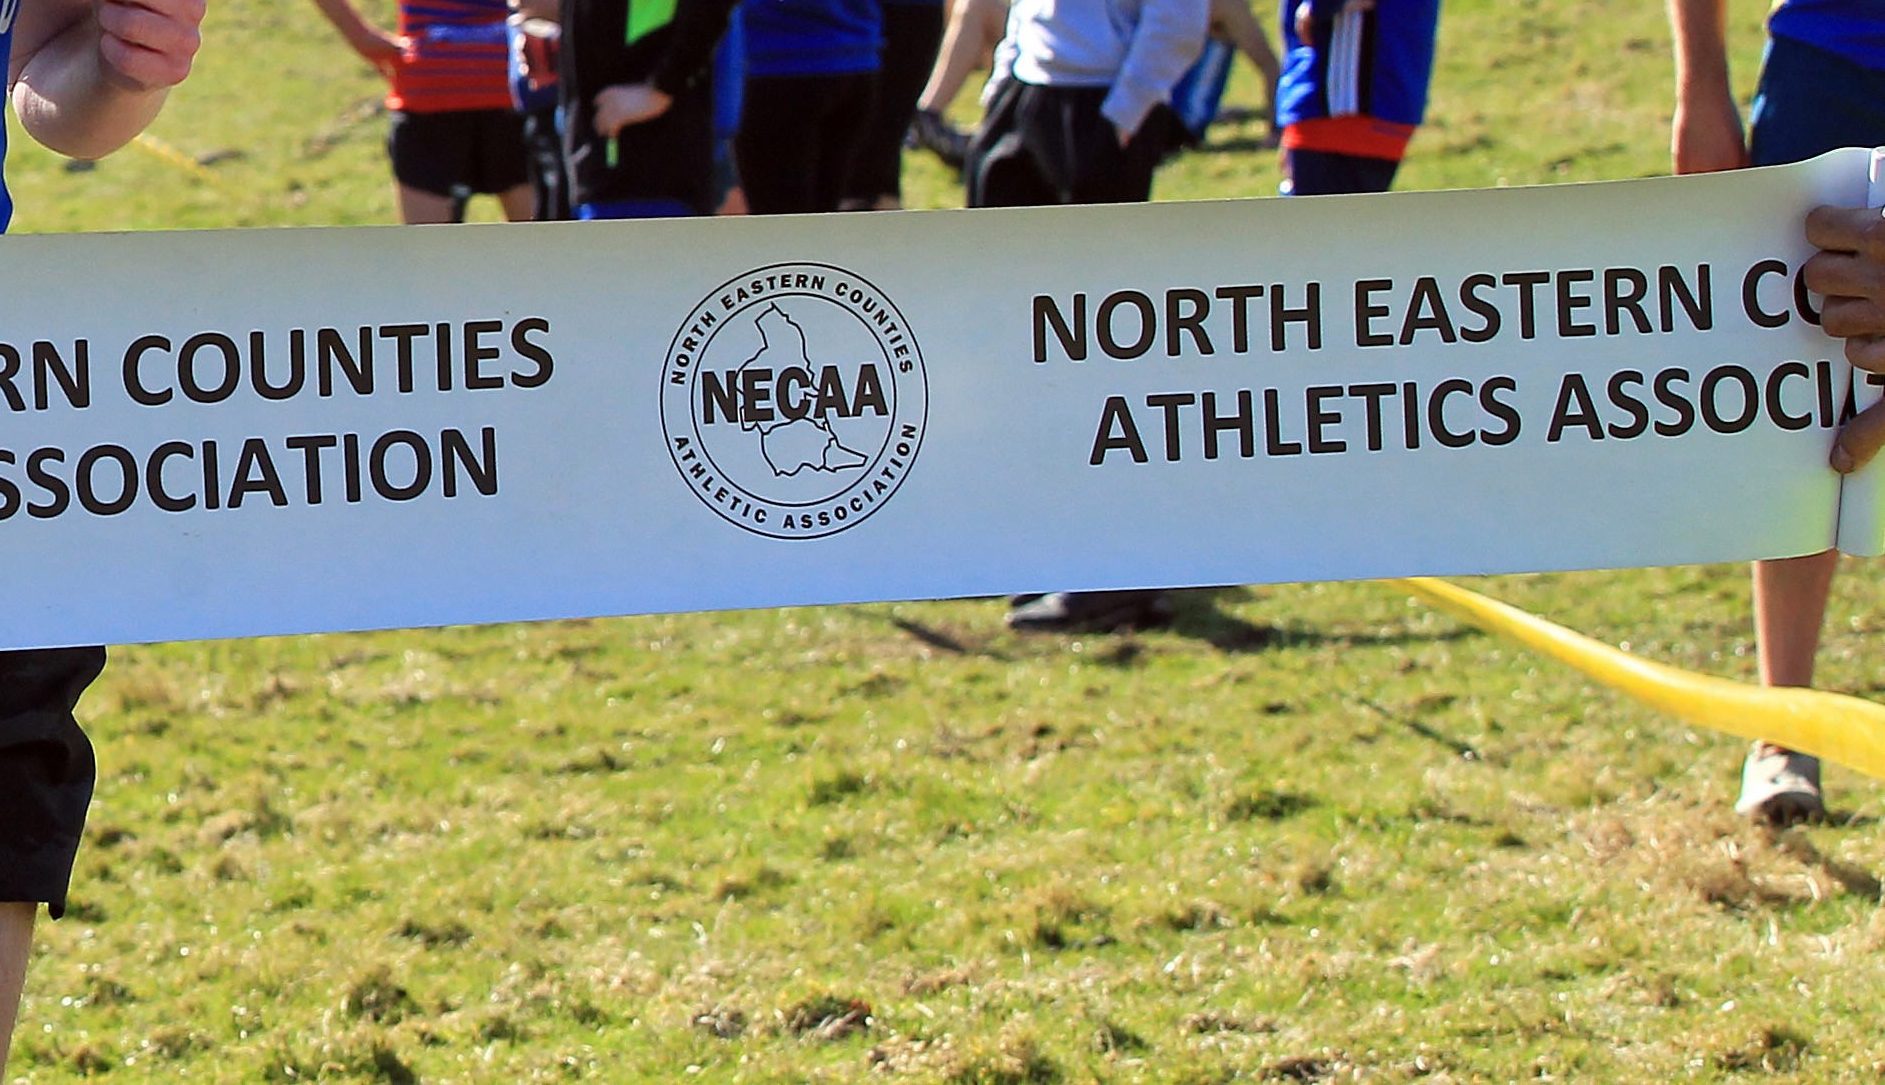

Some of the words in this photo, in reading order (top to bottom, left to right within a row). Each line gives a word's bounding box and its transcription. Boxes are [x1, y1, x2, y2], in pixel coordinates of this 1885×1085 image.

[122, 317, 554, 406] COUNTIES
[671, 311, 717, 385] NORTH
[720, 274, 825, 311] EASTERN
[835, 282, 913, 373] COUNTIES
[1033, 282, 1322, 363] NORTH
[1355, 264, 1713, 347] EASTERN
[701, 363, 889, 424] NECAA
[1089, 376, 1522, 466] ATHLETICS
[1547, 361, 1885, 442] ASSOCI
[674, 437, 767, 524] ATHLETIC
[782, 424, 917, 529] ASSOCIATION
